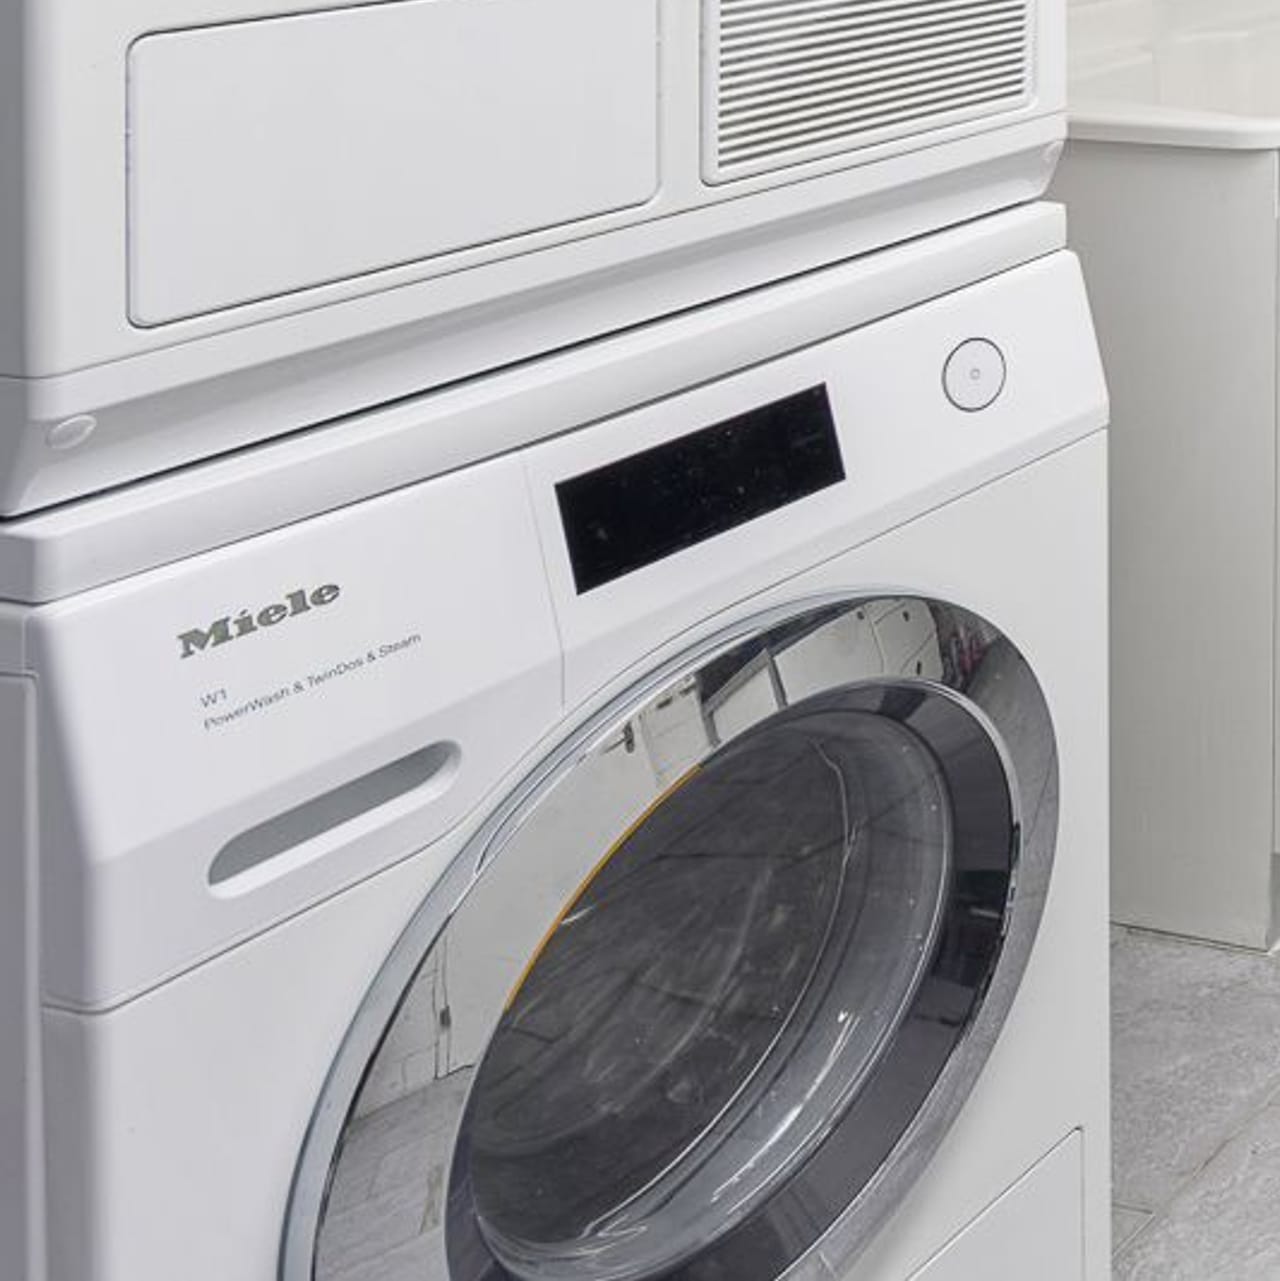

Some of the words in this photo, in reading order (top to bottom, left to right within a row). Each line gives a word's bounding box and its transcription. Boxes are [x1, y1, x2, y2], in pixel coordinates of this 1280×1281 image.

[177, 584, 340, 659] Miele
[200, 687, 228, 708] W1
[203, 687, 290, 731] PowerWash
[293, 681, 305, 693] &
[307, 659, 364, 687] TwinDos
[367, 651, 376, 662] &
[379, 634, 421, 658] Steam
